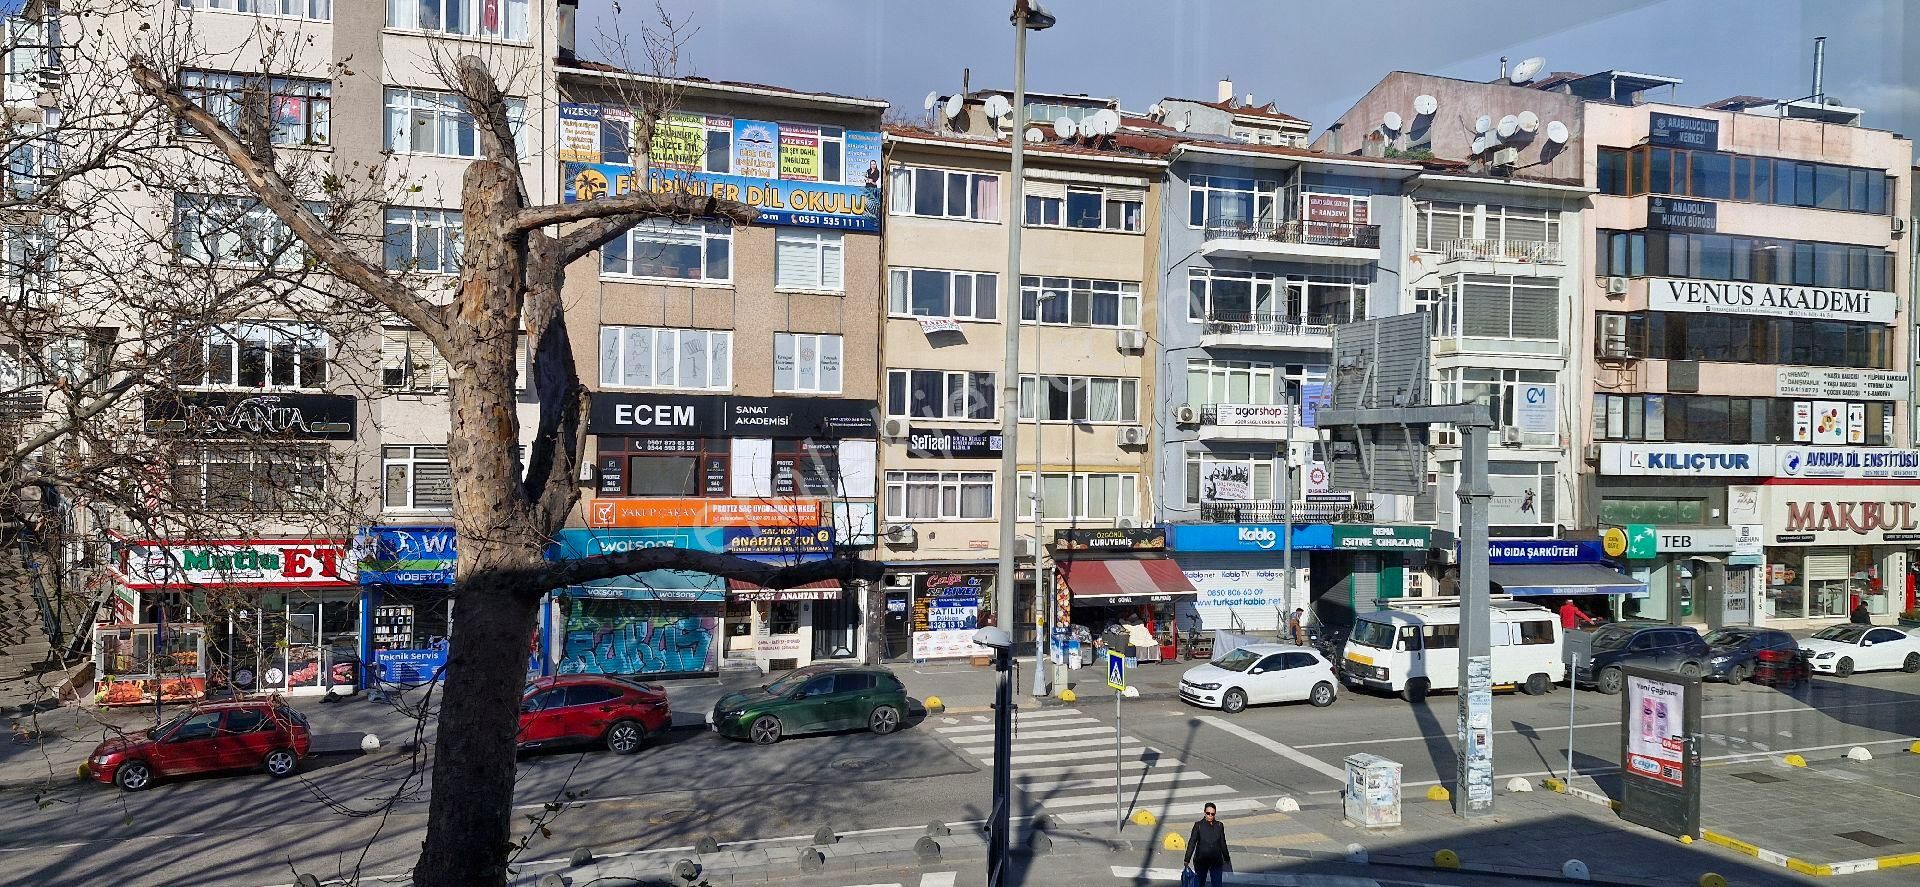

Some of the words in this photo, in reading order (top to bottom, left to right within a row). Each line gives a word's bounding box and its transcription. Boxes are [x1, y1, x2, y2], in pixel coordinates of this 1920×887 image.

[563, 107, 598, 117] VİZESİZ
[782, 137, 813, 146] VİZESİZ
[616, 171, 739, 201] FİİPİNLER
[748, 182, 784, 209] DİL
[790, 188, 866, 215] OKULU
[1672, 202, 1706, 214] ANADOLU
[799, 216, 820, 224] 0551
[823, 217, 839, 226] 535
[1662, 214, 1686, 226] HUKUK
[1687, 215, 1716, 228] BÜROSU
[1668, 281, 1753, 306] VENUS
[1760, 287, 1871, 313] AKADEMİ
[615, 404, 695, 427] ECEM
[735, 406, 768, 415] SANAT
[1236, 407, 1282, 418] agorshop
[735, 414, 790, 426] AKADEMİSİ
[1649, 452, 1750, 473] KILIÇTUR
[1805, 452, 1844, 467] AVRUPA
[1845, 450, 1860, 467] DİL
[1864, 451, 1919, 468] ENSTİTÜSÜ
[712, 504, 737, 512] PROTEZ
[738, 505, 752, 514] SAÇ
[1785, 502, 1918, 535] MAKBUL
[731, 536, 791, 546] ANAHTAR
[820, 533, 827, 541] 2
[1238, 526, 1277, 541] Kablo
[1090, 537, 1132, 547] KURUYEMİŞ
[1662, 535, 1692, 547] TEB
[1504, 547, 1526, 557] GIDA
[1527, 545, 1578, 559] ŞARKÜTERİ
[281, 548, 346, 577] ET
[587, 588, 624, 596] watsons
[659, 590, 696, 598] watsons
[781, 592, 818, 600] ANAHTAR
[823, 591, 836, 599] EVİ
[1206, 588, 1225, 597] 0850
[1228, 588, 1241, 597] 806
[1254, 588, 1264, 596] 09
[931, 608, 965, 616] SATILIK
